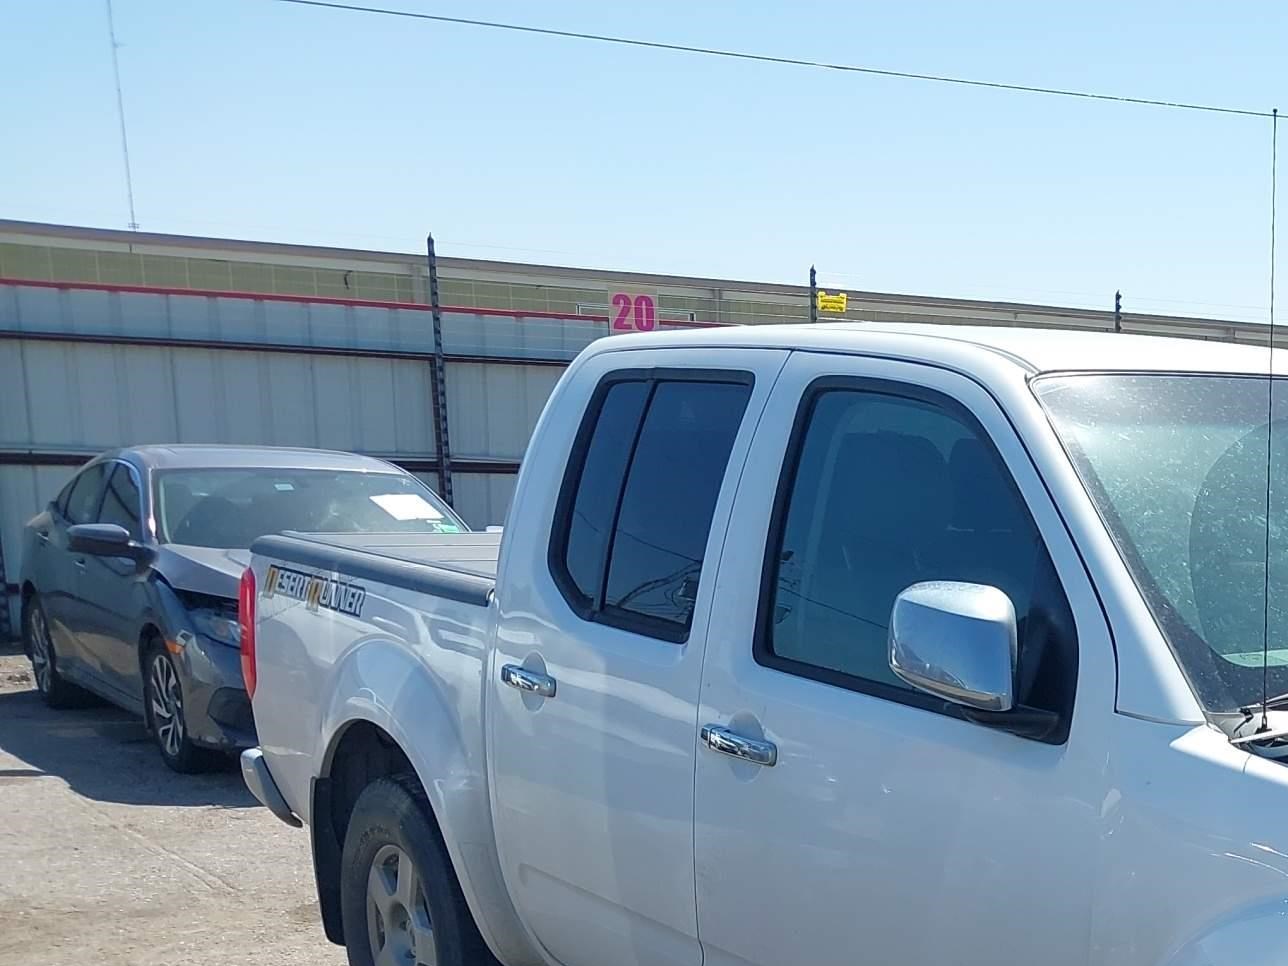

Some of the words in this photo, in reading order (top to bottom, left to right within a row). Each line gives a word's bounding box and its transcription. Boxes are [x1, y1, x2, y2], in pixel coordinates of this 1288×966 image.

[612, 293, 655, 331] 20
[263, 565, 312, 602] DESERT
[305, 576, 366, 618] RUNNER
